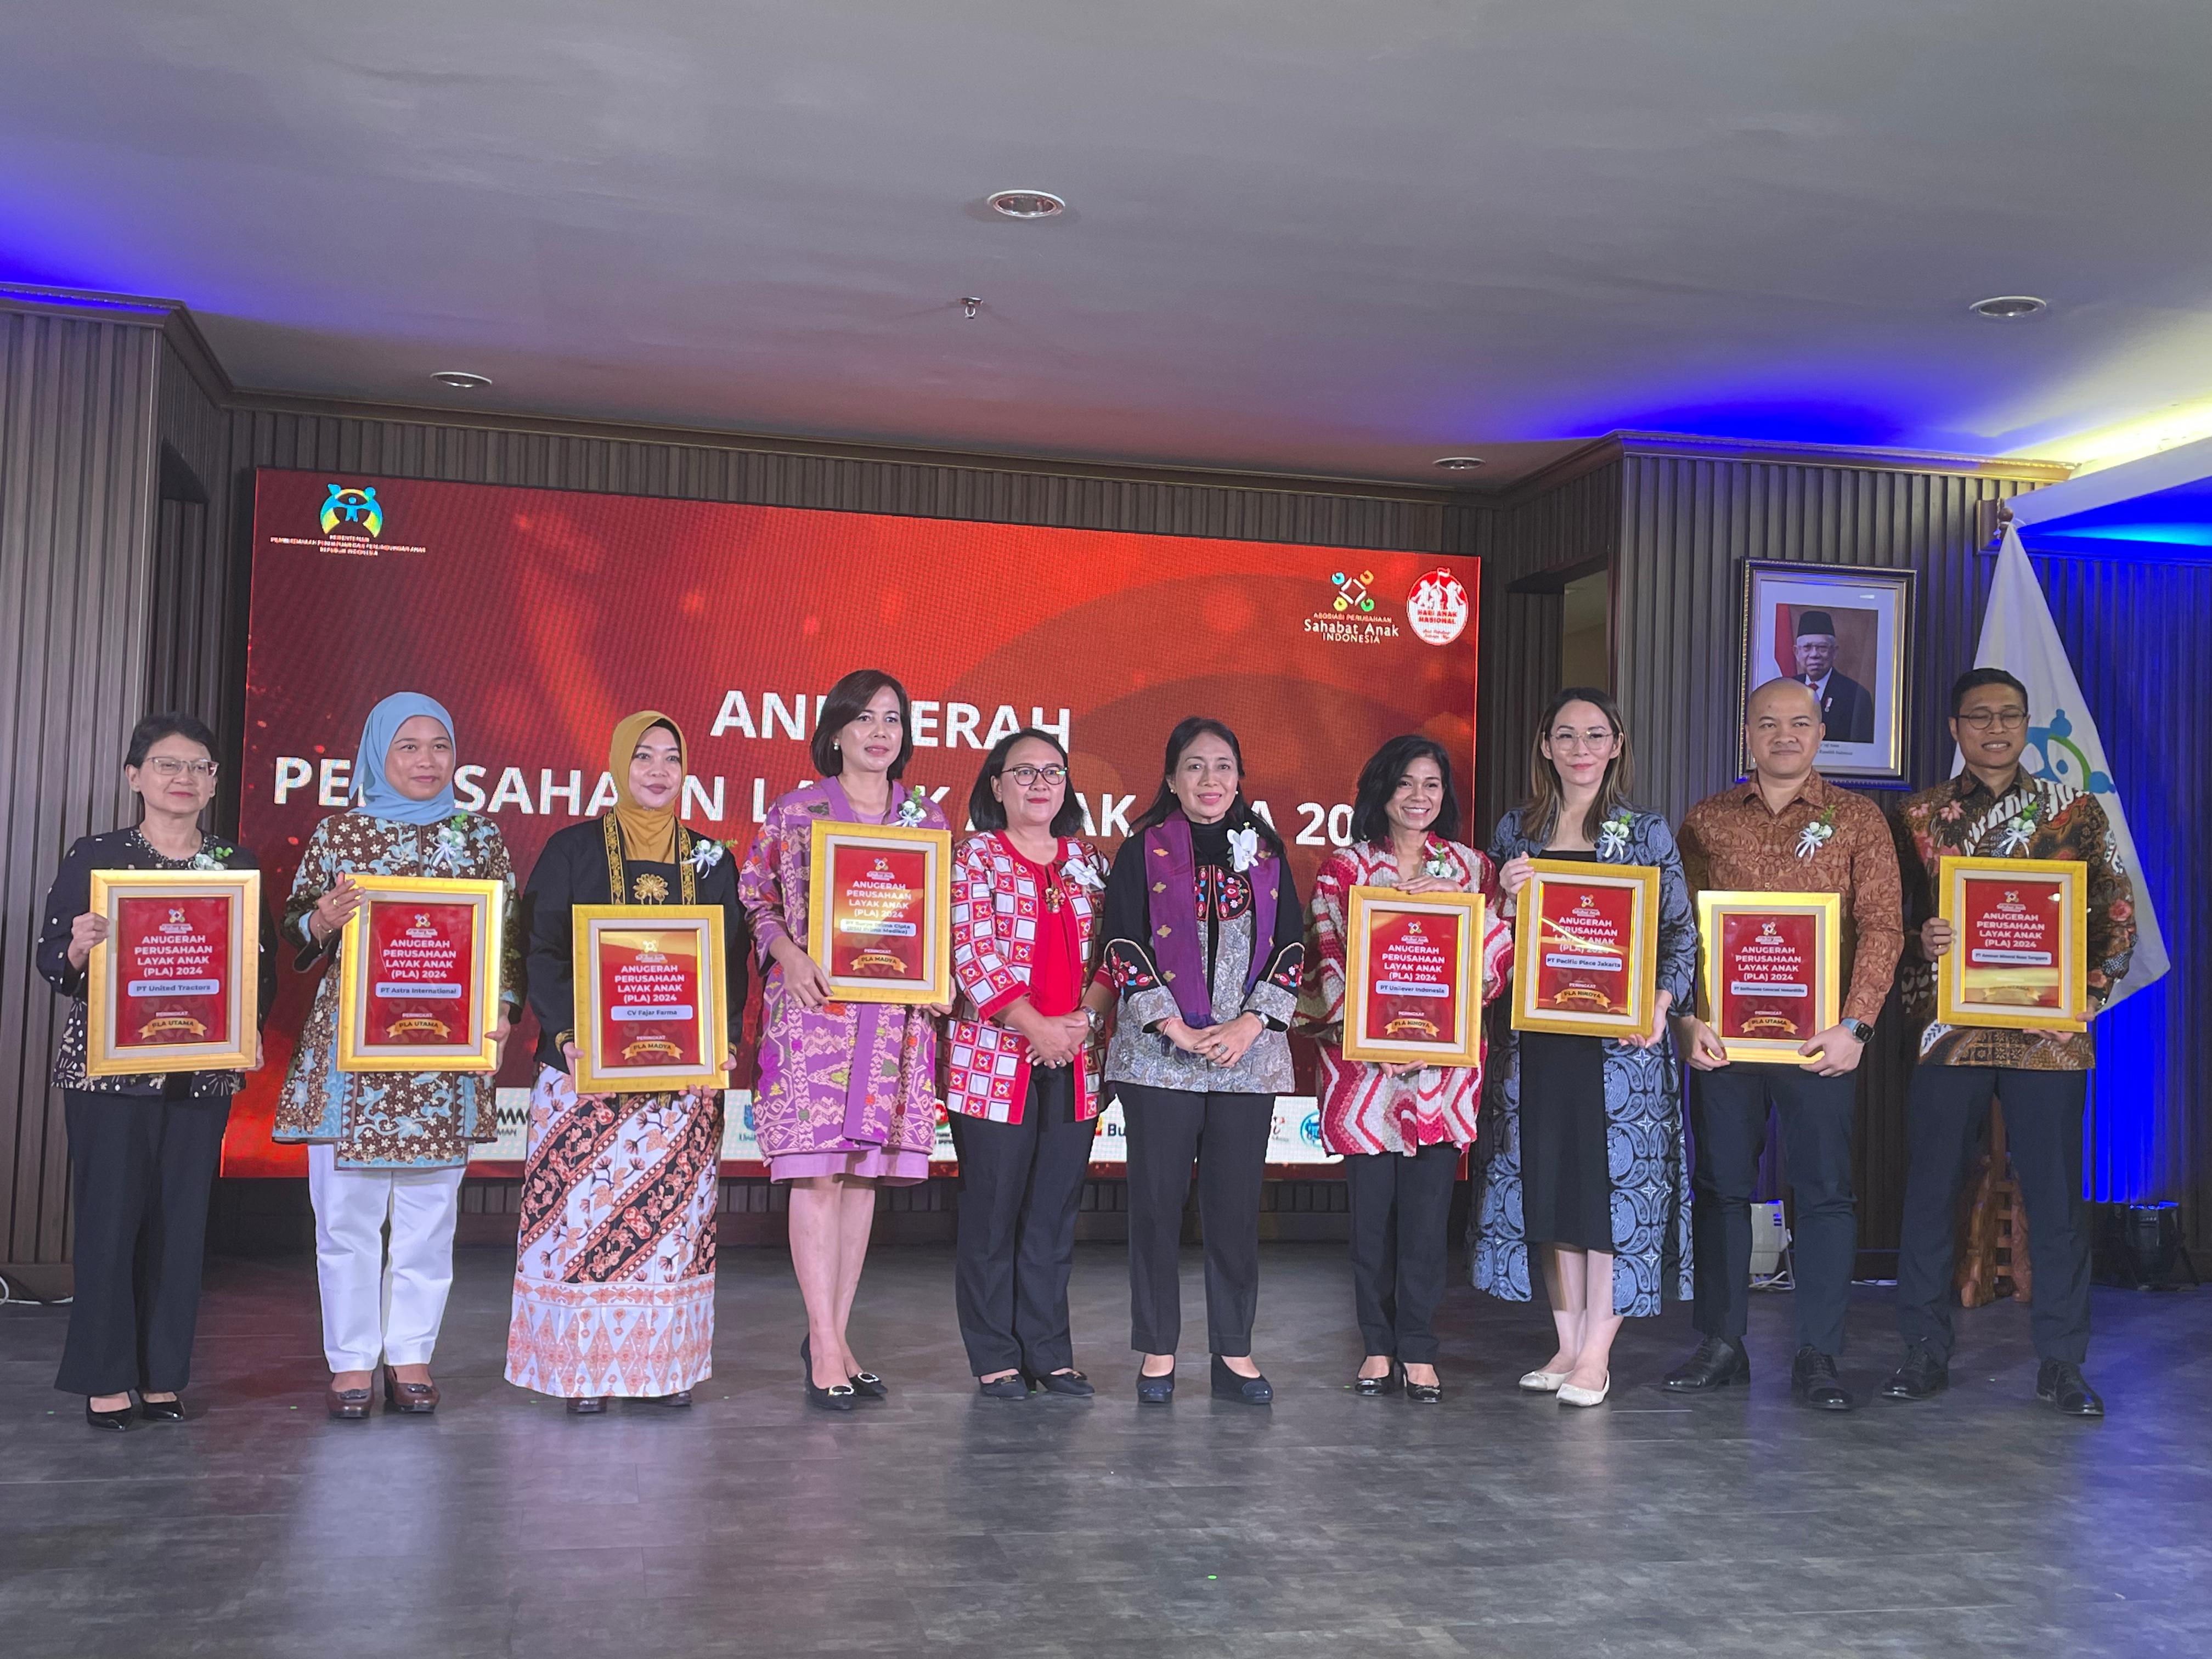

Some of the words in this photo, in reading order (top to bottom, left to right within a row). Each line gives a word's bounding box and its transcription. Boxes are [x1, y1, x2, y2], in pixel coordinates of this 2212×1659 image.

[1304, 619, 1358, 634] Sahabat
[1364, 623, 1399, 637] Anak
[1323, 633, 1380, 644] INDONESIA
[710, 690, 1070, 753] ANERAH
[274, 757, 725, 821] PESAHAN
[853, 881, 906, 890] ANUGERAH
[847, 890, 911, 900] PERUSAHAAN
[849, 899, 879, 908] LAYAK
[882, 901, 909, 909] ANAK
[855, 909, 878, 918] (PLA)
[882, 910, 904, 918] 2024
[1983, 913, 2038, 921] ANUGERAH
[1559, 917, 1612, 927] ANUGERAH
[1977, 921, 2045, 930] PERUSAHAAN
[1979, 930, 2011, 938] LAYAK
[142, 935, 205, 944] ANUGERAH
[1588, 936, 1615, 945] ANAK
[1985, 939, 2011, 948] (PLA)
[134, 946, 212, 955] PERUSAHAAN
[1388, 945, 1439, 953] ANUGERAH
[383, 950, 456, 958] PERUSAHAAN
[1382, 953, 1445, 963] PERUSAHAAN
[138, 957, 173, 966] LAYAK
[177, 956, 209, 964] ANAK
[144, 968, 173, 977] (PLA)
[176, 967, 202, 975] 2024
[1384, 963, 1414, 972] LAYAK
[1416, 964, 1442, 973] ANAK
[391, 970, 419, 979] (PLA)
[422, 970, 447, 979] 2024
[614, 974, 685, 983] PERUSAHAAN
[1389, 972, 1413, 981] (PLA)
[1744, 973, 1769, 981] (PLA)
[624, 995, 650, 1003] (PLA)
